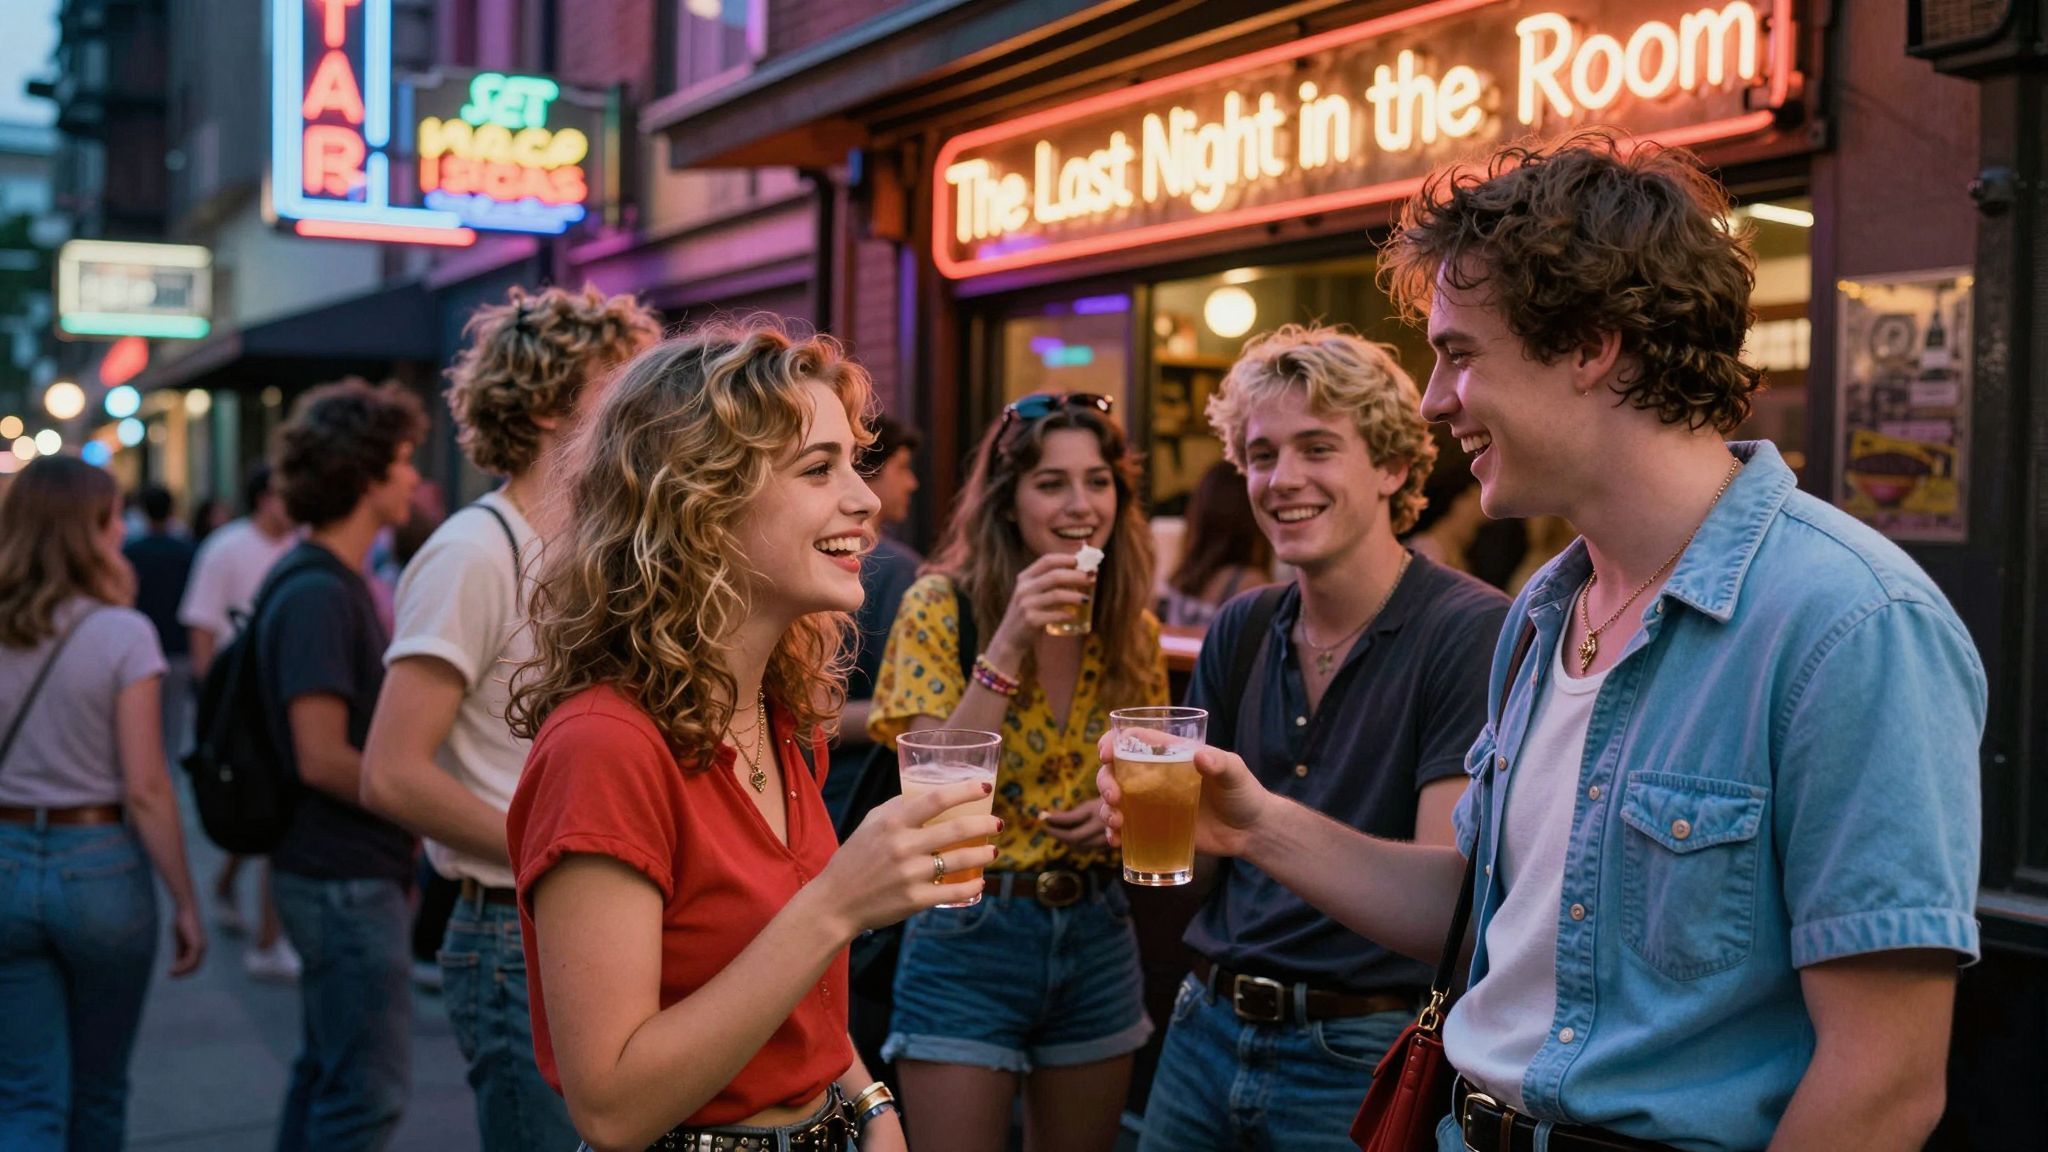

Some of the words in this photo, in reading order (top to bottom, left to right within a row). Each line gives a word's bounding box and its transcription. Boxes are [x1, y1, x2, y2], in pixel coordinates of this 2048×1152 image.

[945, 157, 1030, 244] The
[1033, 130, 1136, 225] Last
[1142, 90, 1287, 213] Night
[1299, 81, 1351, 170] in
[1366, 49, 1482, 152] the
[1515, 0, 1756, 125] Room
